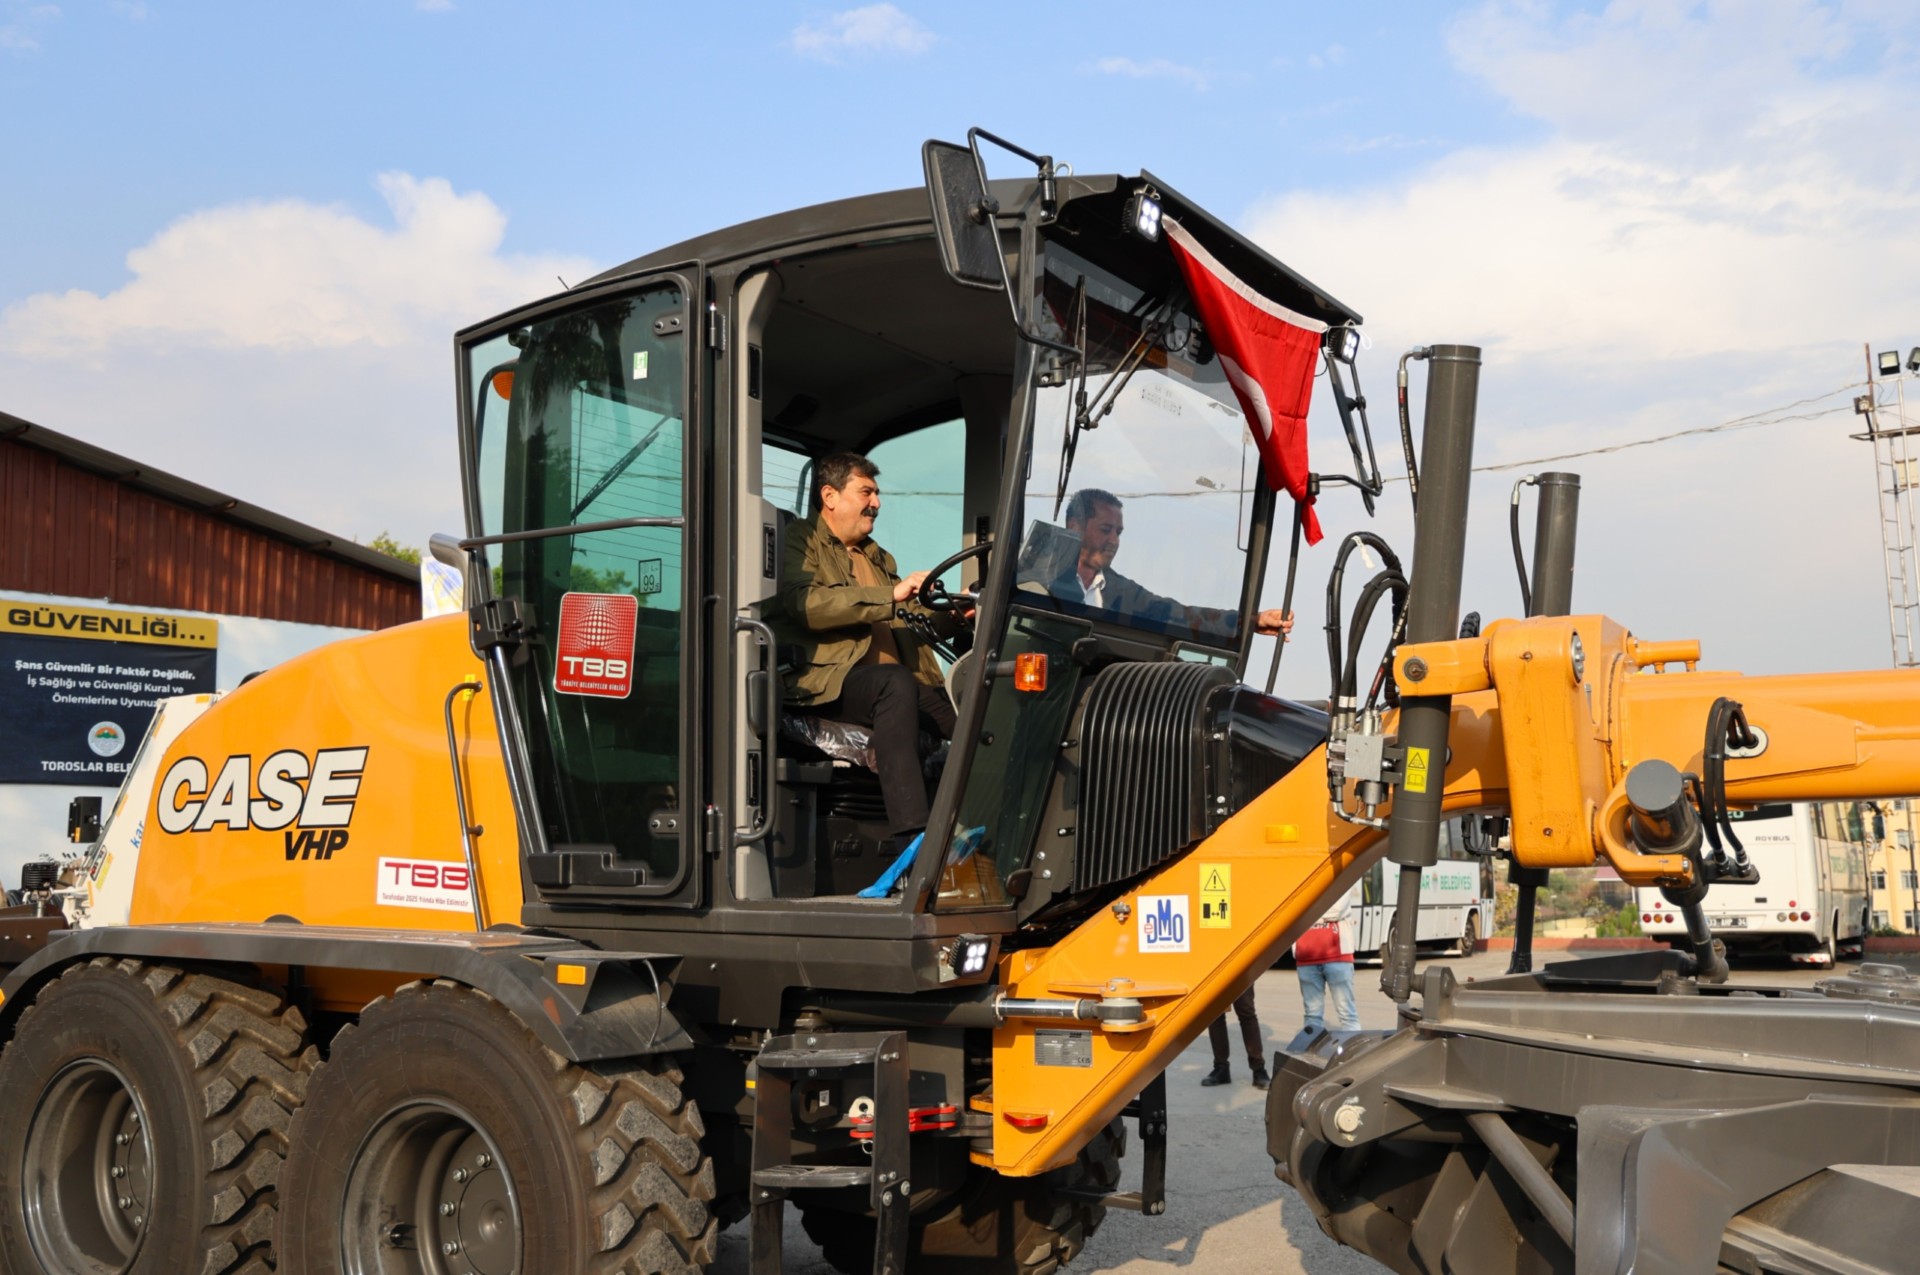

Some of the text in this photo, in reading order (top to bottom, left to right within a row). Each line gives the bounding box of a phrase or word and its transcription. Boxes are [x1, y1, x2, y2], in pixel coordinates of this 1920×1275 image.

[15, 660, 196, 681] Şans Güvenilir Bir Faktör Değildir.
[562, 656, 628, 679] TBB
[27, 674, 37, 688] İş
[39, 677, 76, 689] Sağlığı
[93, 680, 142, 693] Güvenliği
[144, 684, 171, 693] Kural
[172, 686, 184, 694] ve
[52, 692, 118, 705] Önlemlerine
[41, 761, 104, 772] TOROSLAR
[157, 746, 370, 835] CASE
[284, 829, 349, 861] VHP
[385, 862, 469, 890] TBB
